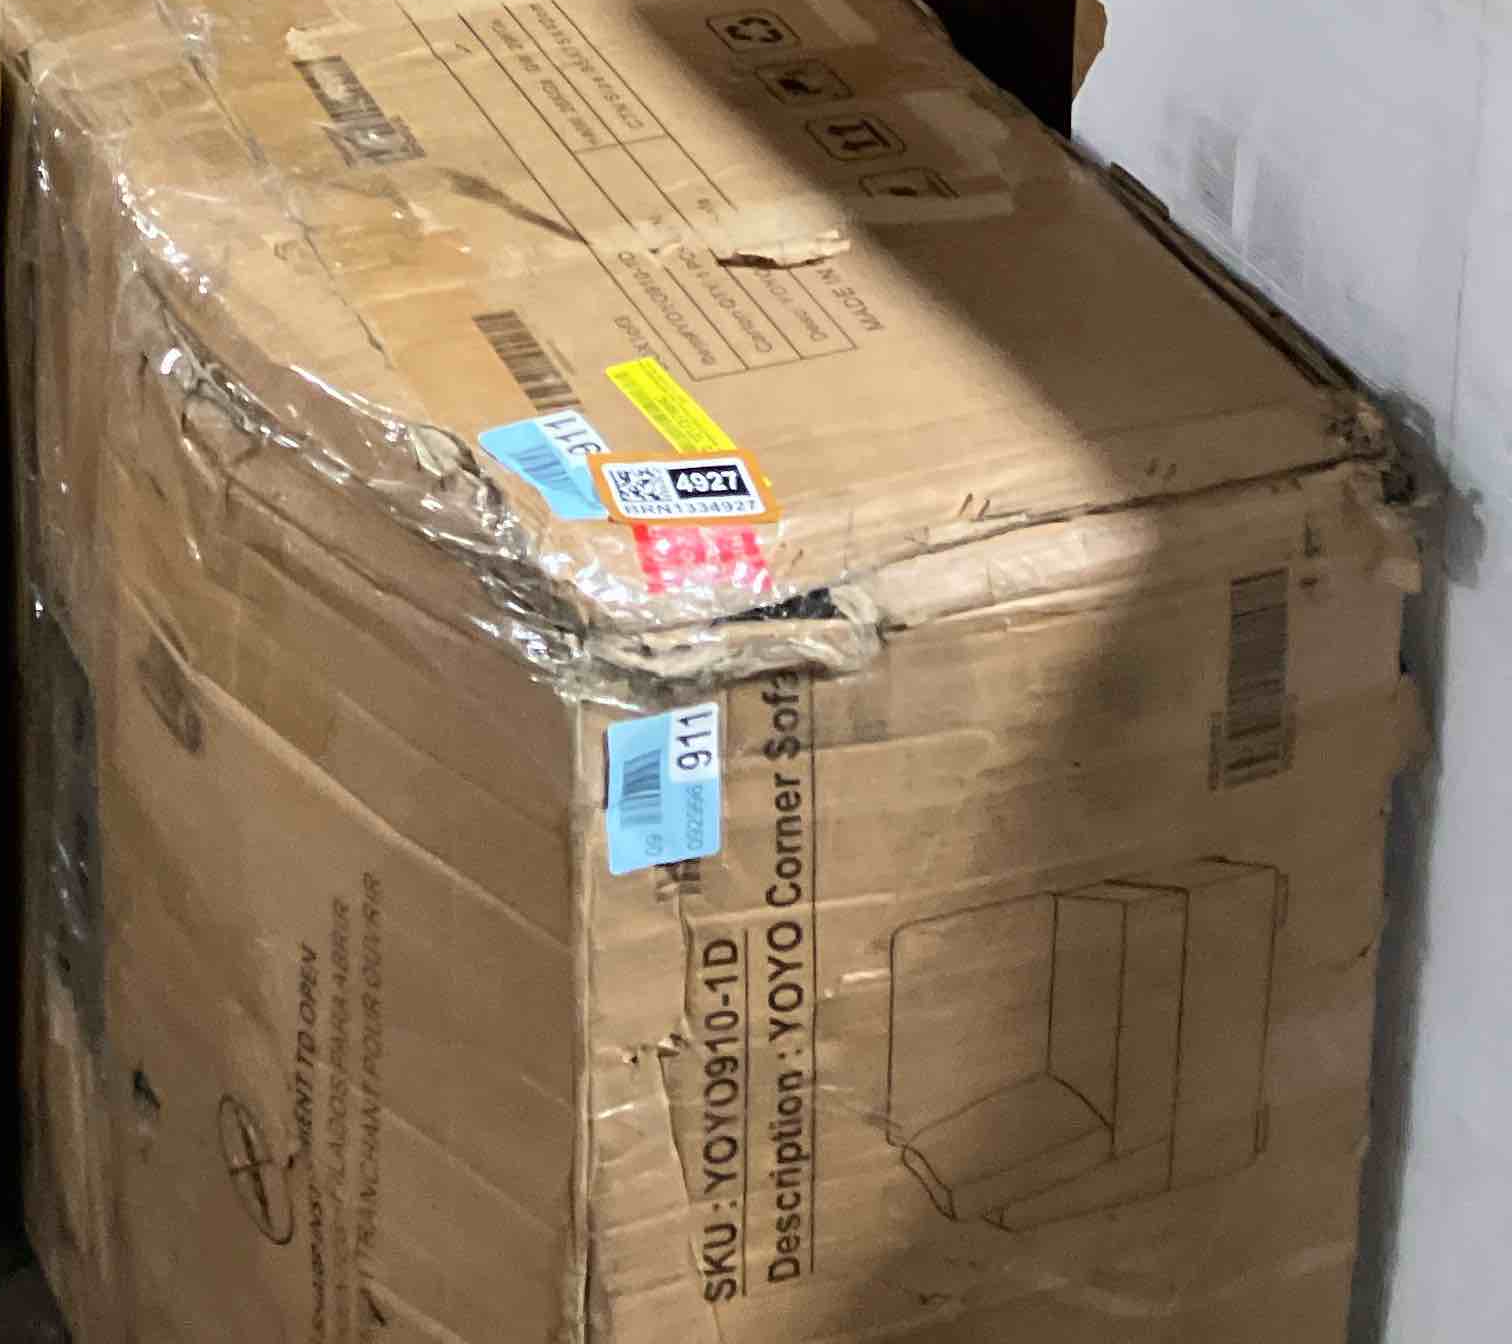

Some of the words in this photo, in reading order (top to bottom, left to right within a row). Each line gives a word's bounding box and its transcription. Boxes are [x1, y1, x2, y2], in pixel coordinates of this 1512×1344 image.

[816, 266, 838, 286] IN
[834, 287, 885, 332] MADE
[675, 469, 739, 495] 4927
[676, 710, 714, 772] 911
[766, 772, 803, 910] Corner
[765, 920, 804, 1043] YOYO
[703, 937, 739, 1195] YOYO910-1D
[767, 1066, 809, 1284] Description
[703, 1222, 738, 1304] SKU
